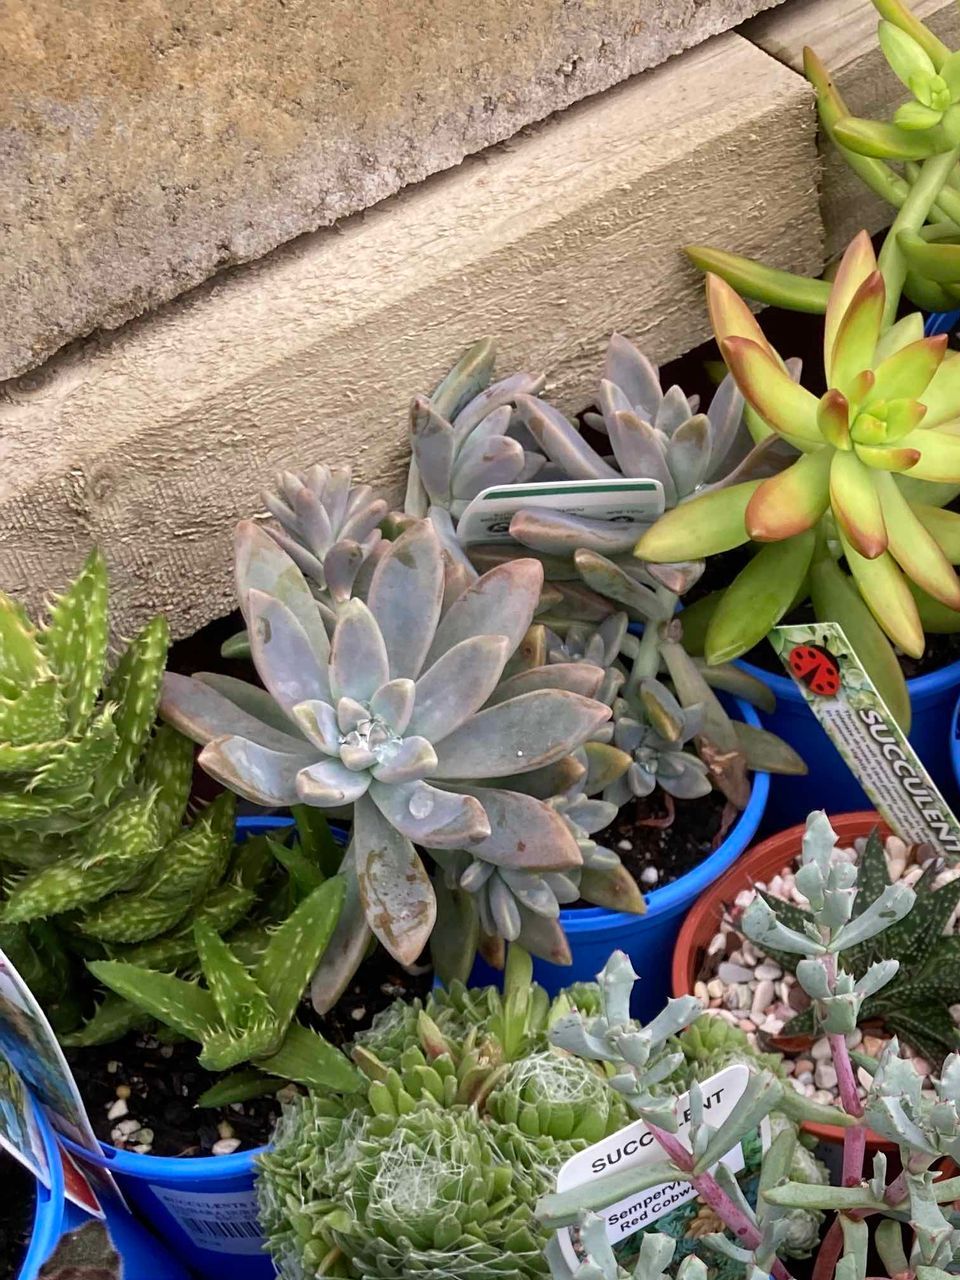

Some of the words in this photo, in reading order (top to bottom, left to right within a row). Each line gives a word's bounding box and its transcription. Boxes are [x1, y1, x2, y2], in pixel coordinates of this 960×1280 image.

[591, 1088, 724, 1174] SUCCENT
[608, 1180, 681, 1226] Sempervi
[620, 1211, 648, 1232] Red
[651, 1185, 695, 1213] Cobw
